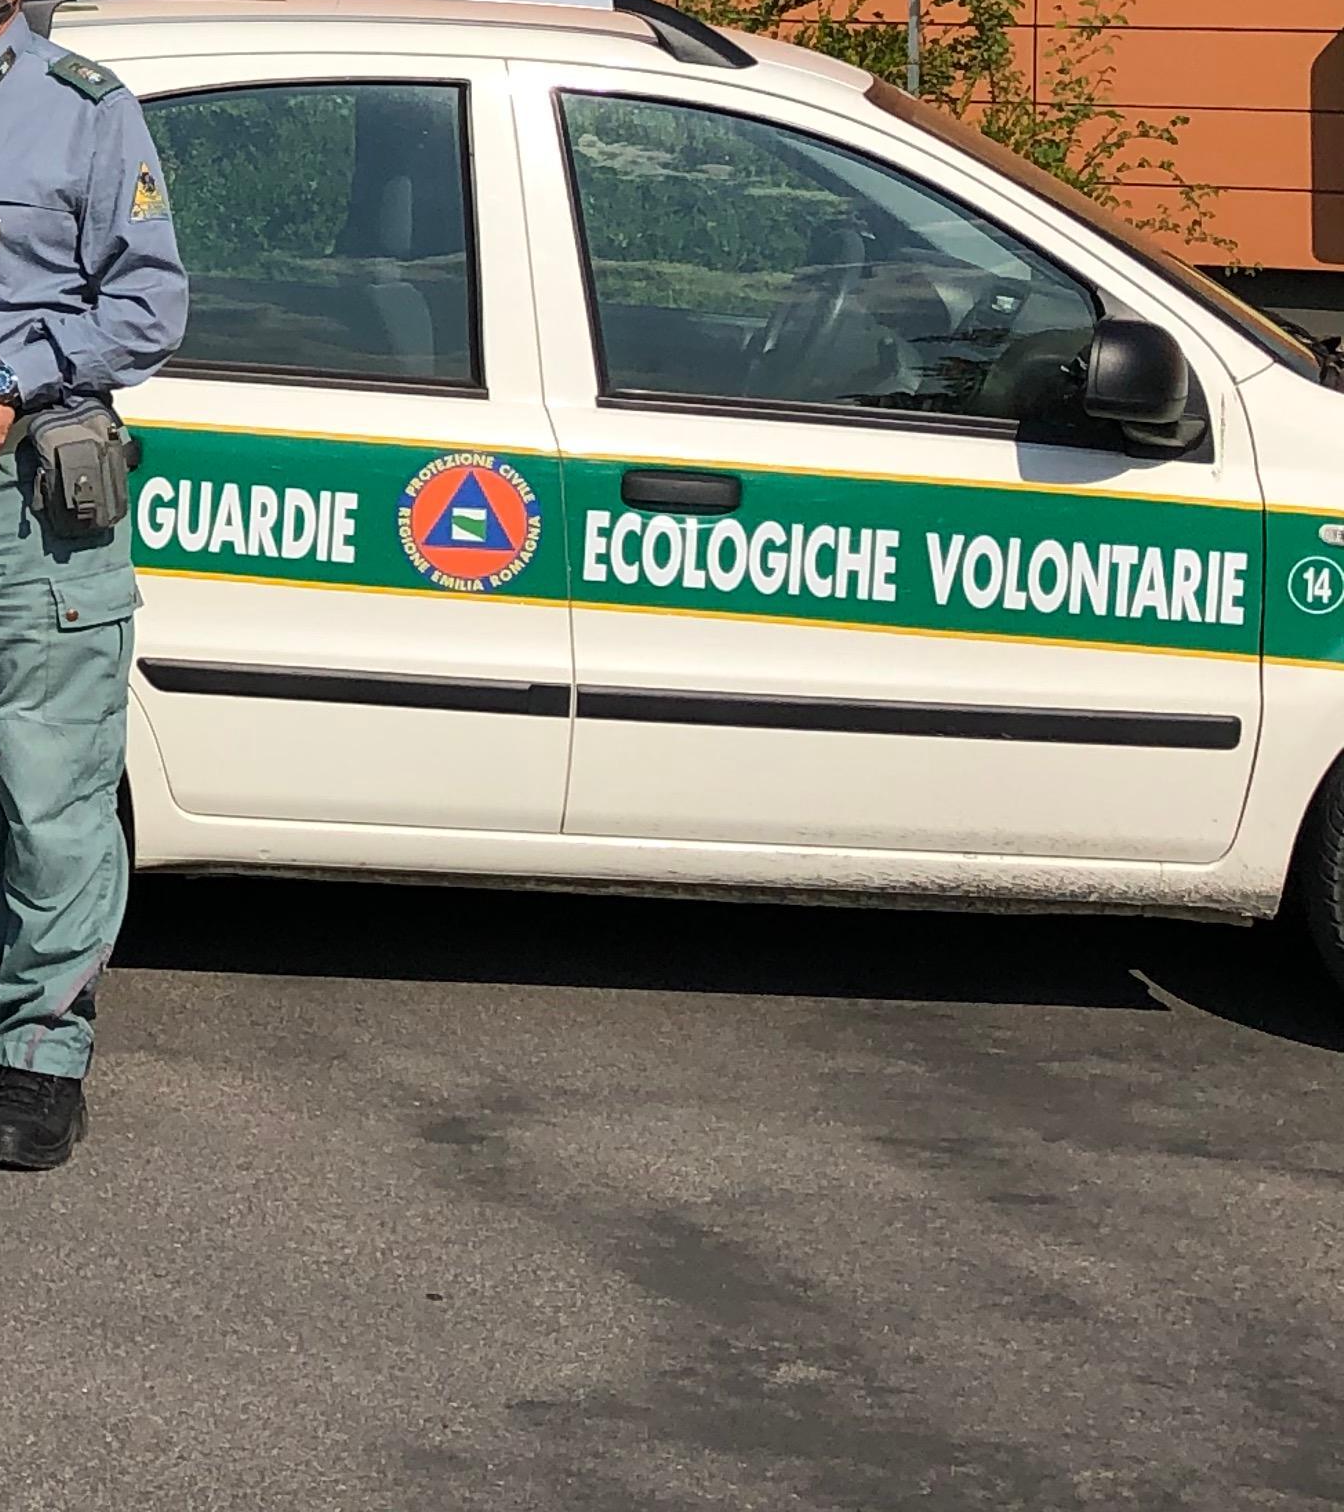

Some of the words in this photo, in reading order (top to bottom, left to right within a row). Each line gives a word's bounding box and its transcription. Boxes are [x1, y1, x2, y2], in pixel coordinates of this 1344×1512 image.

[405, 453, 496, 497] PROTEZIONE
[499, 464, 536, 504] CIVILE
[137, 476, 359, 564] GUARDIE
[582, 509, 900, 602] ECOLOGICHE
[925, 532, 1248, 626] VOLONTARIE
[398, 507, 431, 574] REGIONE
[430, 570, 485, 591] EMILIA
[489, 516, 542, 587] ROMAGNA
[1302, 566, 1332, 604] 14
